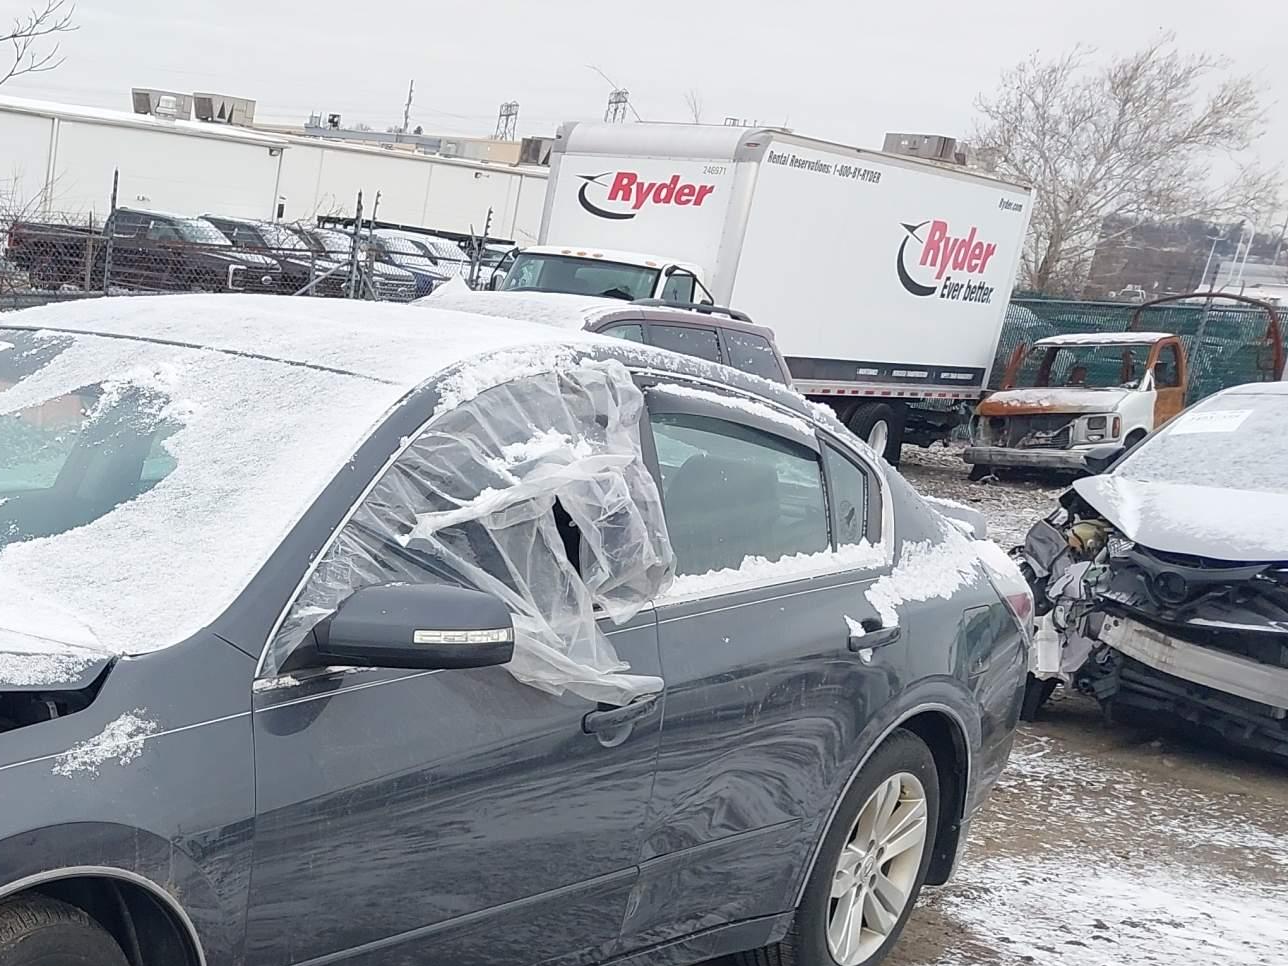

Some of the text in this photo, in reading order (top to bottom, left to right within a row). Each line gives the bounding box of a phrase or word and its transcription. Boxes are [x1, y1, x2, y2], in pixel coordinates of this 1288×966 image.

[768, 150, 882, 184] Rental Reservations: 1-800-BY-RYDER
[608, 172, 715, 210] Ryder
[998, 197, 1023, 212] Ryder.com
[919, 220, 997, 280] Ryder
[940, 276, 994, 304] Ever better.
